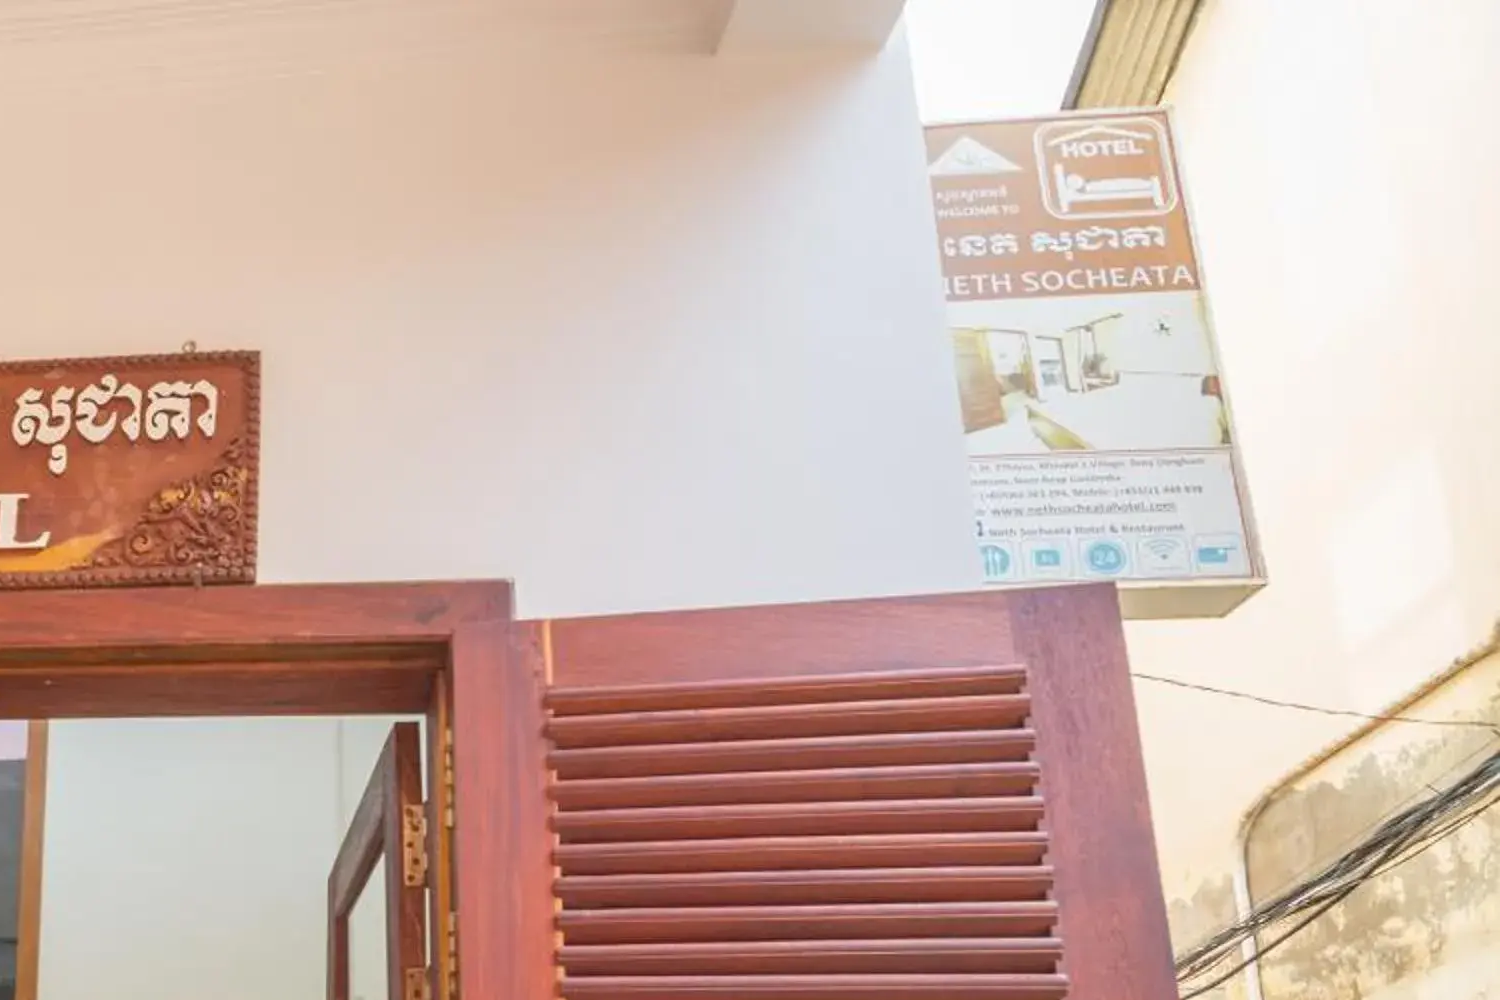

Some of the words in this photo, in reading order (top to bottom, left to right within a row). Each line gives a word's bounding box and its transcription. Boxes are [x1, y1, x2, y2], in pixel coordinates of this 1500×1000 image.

[1061, 139, 1144, 158] HOTEL
[1021, 264, 1194, 293] SOCHEATA
[11, 373, 218, 475] សុជាតា
